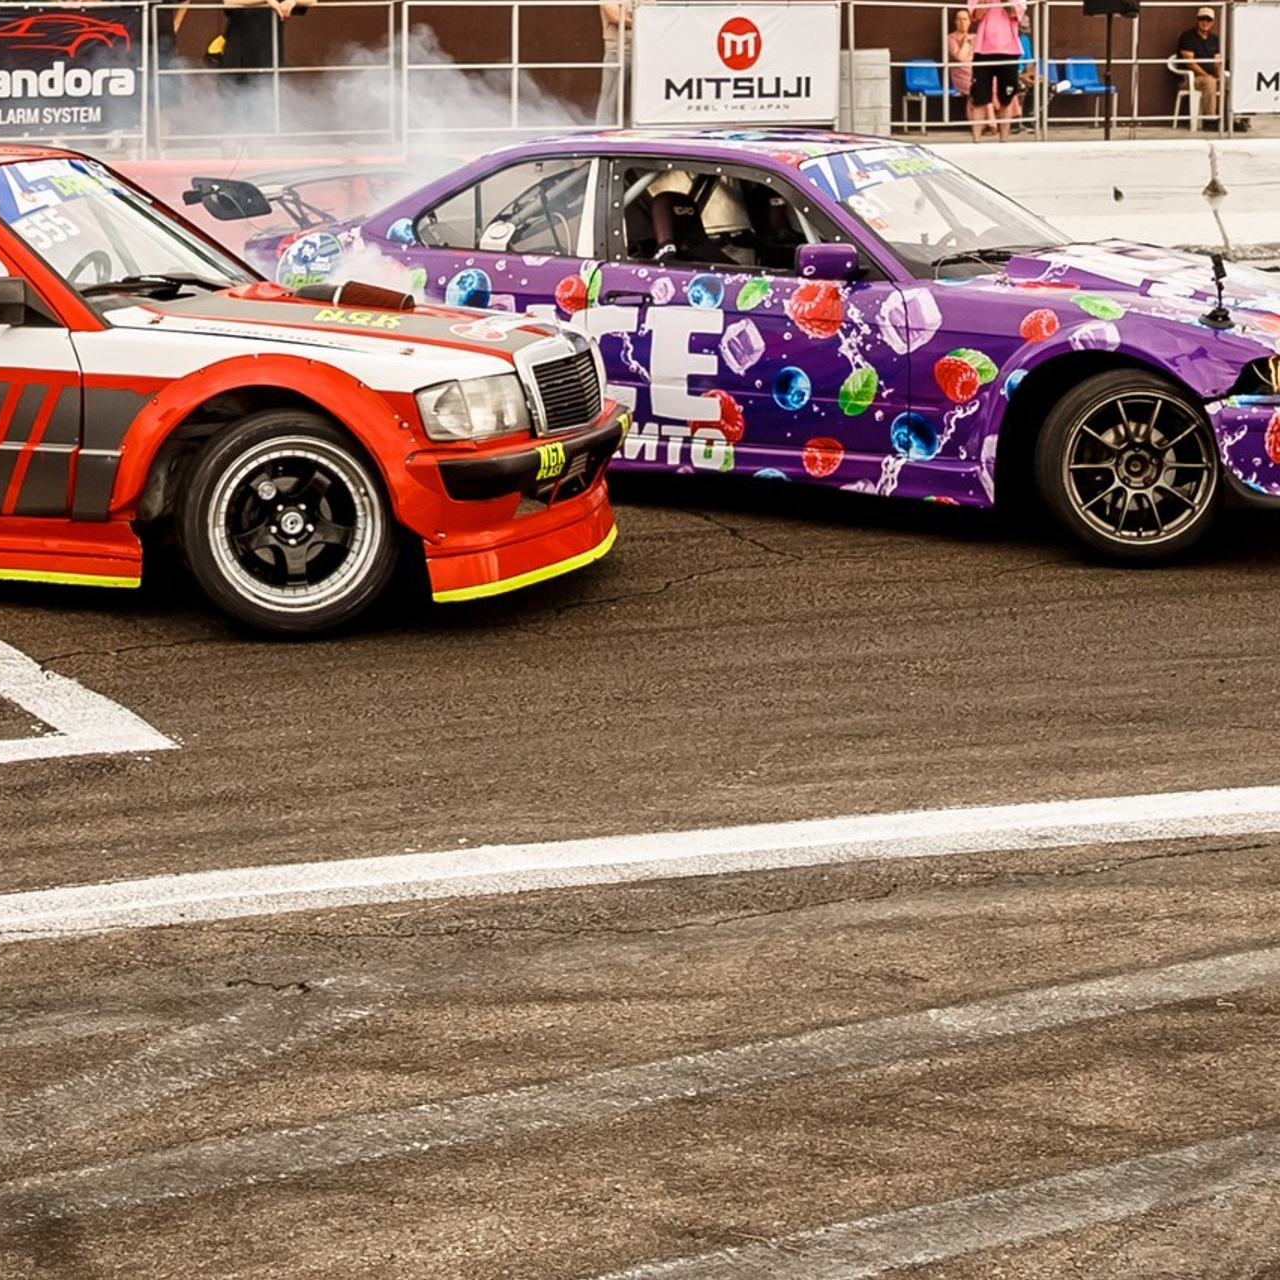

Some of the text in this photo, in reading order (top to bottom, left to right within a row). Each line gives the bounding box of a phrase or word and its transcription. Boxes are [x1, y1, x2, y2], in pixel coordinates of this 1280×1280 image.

[664, 76, 811, 100] MITSUJI
[42, 107, 102, 125] SYSTEM
[22, 208, 81, 250] 555
[612, 422, 728, 470] ИТО
